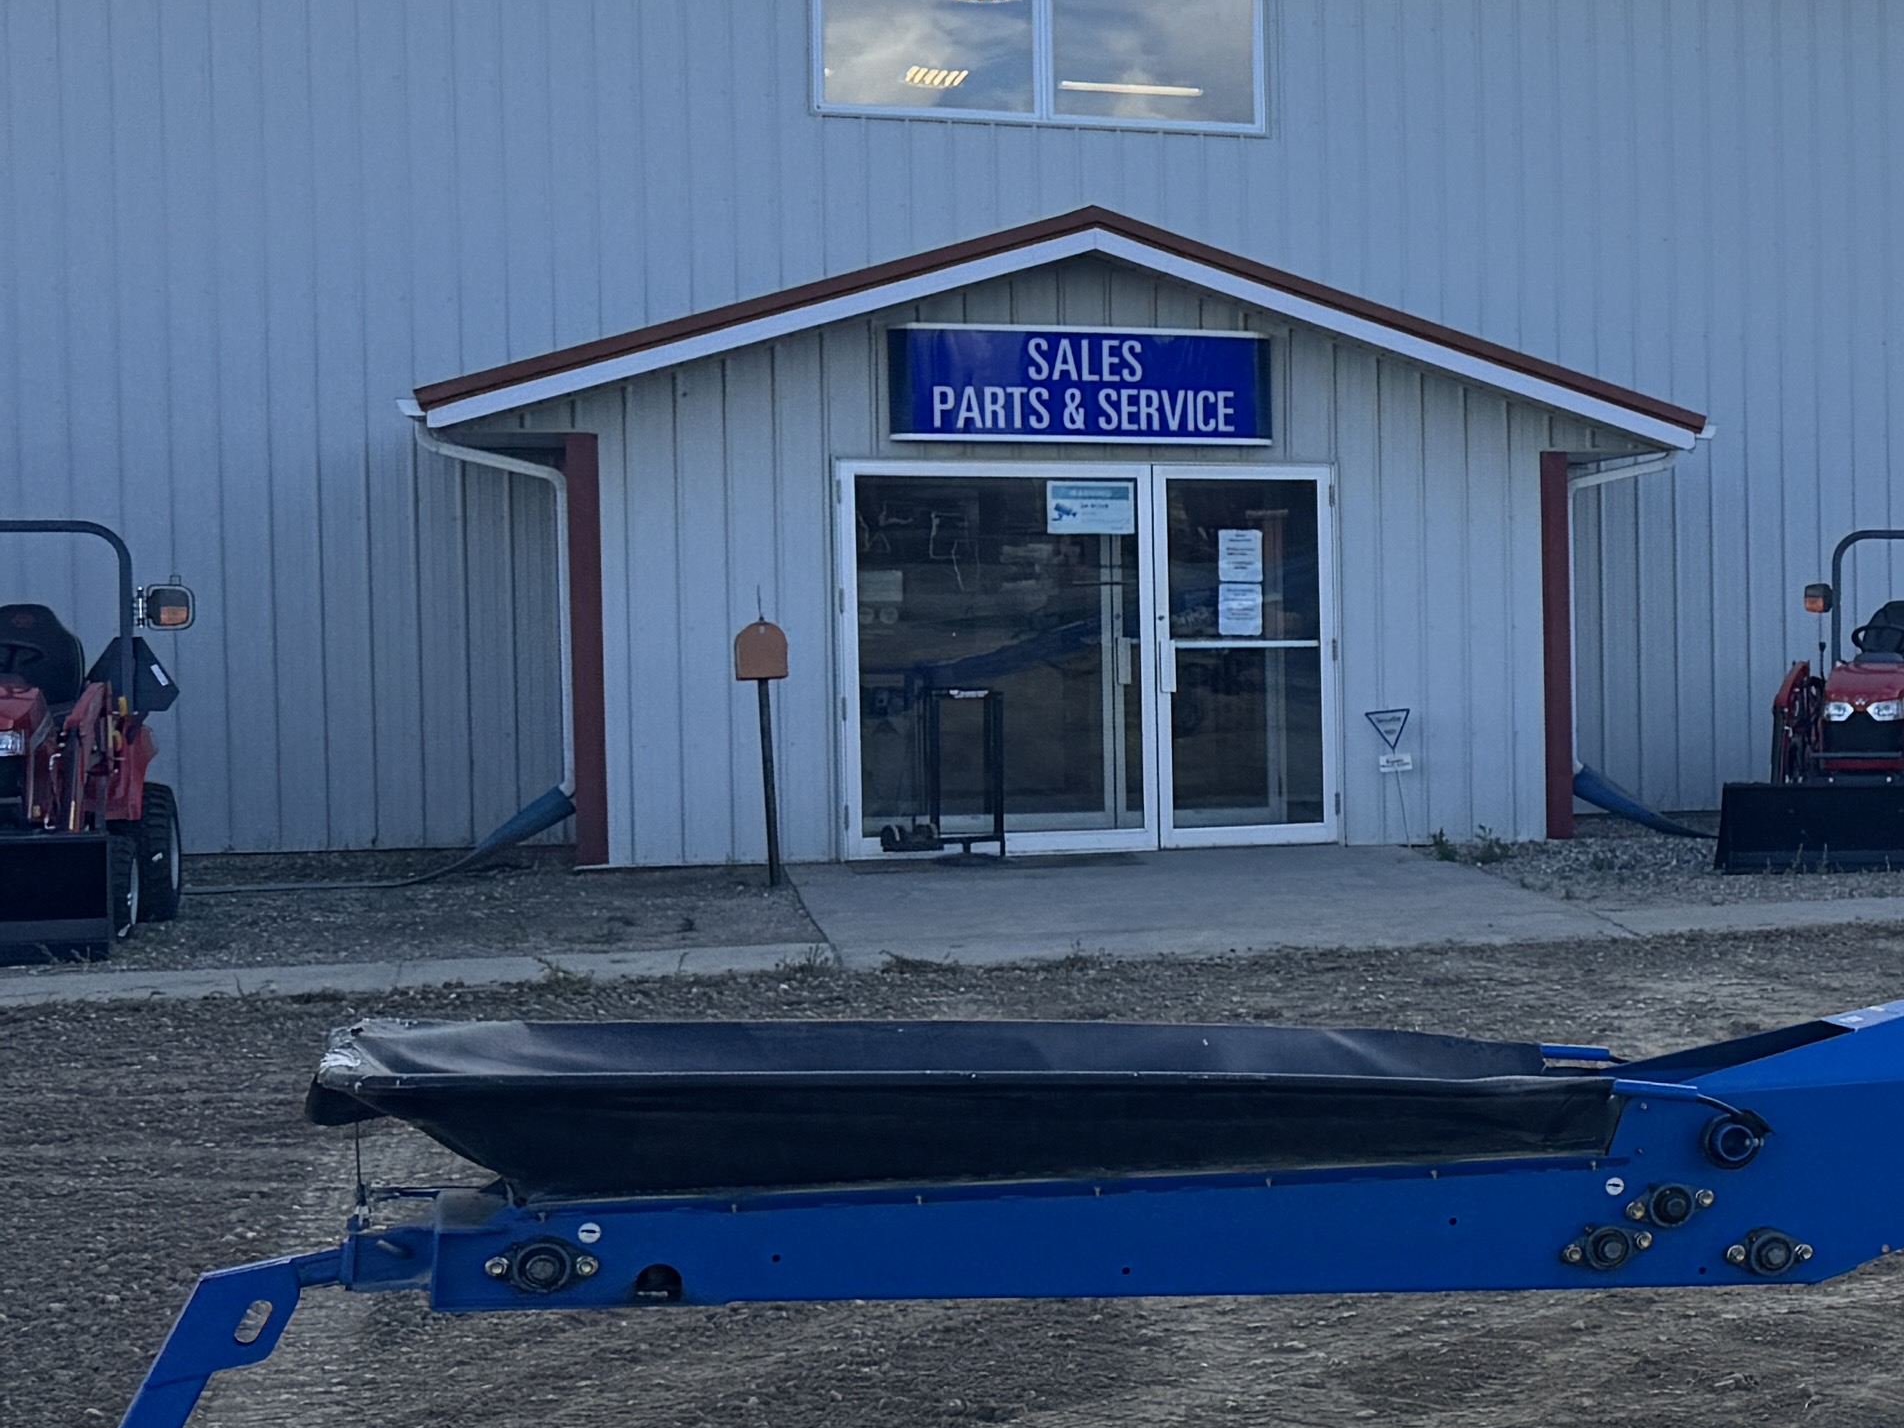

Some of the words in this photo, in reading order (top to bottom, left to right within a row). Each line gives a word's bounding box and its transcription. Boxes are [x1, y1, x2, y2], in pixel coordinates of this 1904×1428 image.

[1027, 337, 1143, 383] SALES
[933, 385, 1050, 430] PARTS
[1063, 388, 1086, 430] &
[1098, 388, 1235, 432] SERVICE
